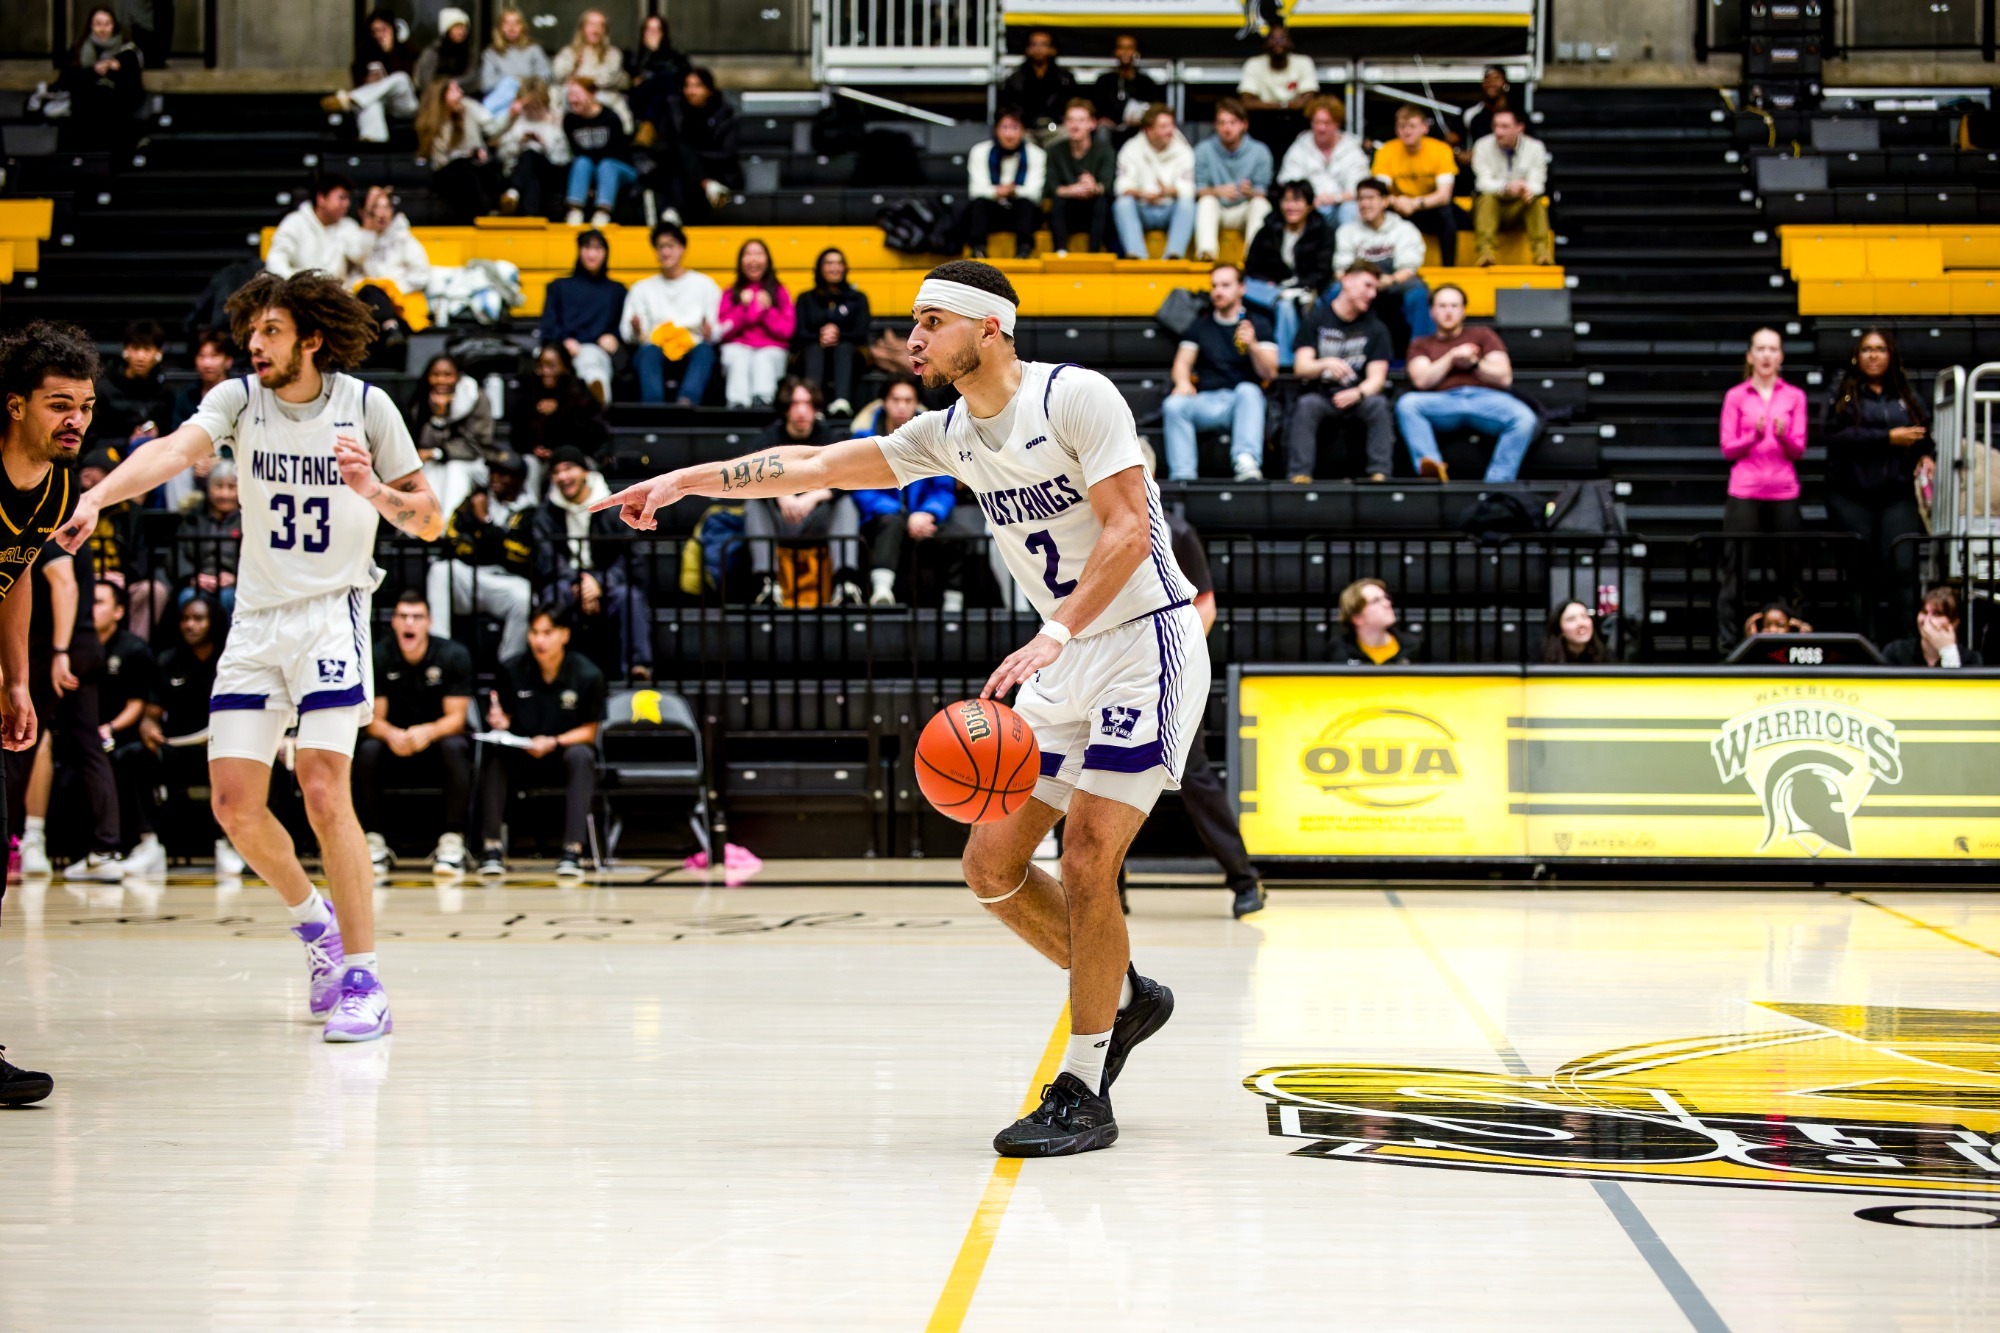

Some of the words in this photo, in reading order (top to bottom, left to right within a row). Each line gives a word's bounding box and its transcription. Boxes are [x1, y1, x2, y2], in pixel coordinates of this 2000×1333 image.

[1025, 435, 1047, 450] OUA
[252, 450, 347, 486] MUSTANG
[720, 454, 785, 492] 1975
[270, 493, 331, 553] 33
[1025, 529, 1079, 599] 2
[1789, 647, 1824, 664] POSS
[1304, 747, 1458, 775] OUA
[1712, 707, 1902, 783] WARRIORS
